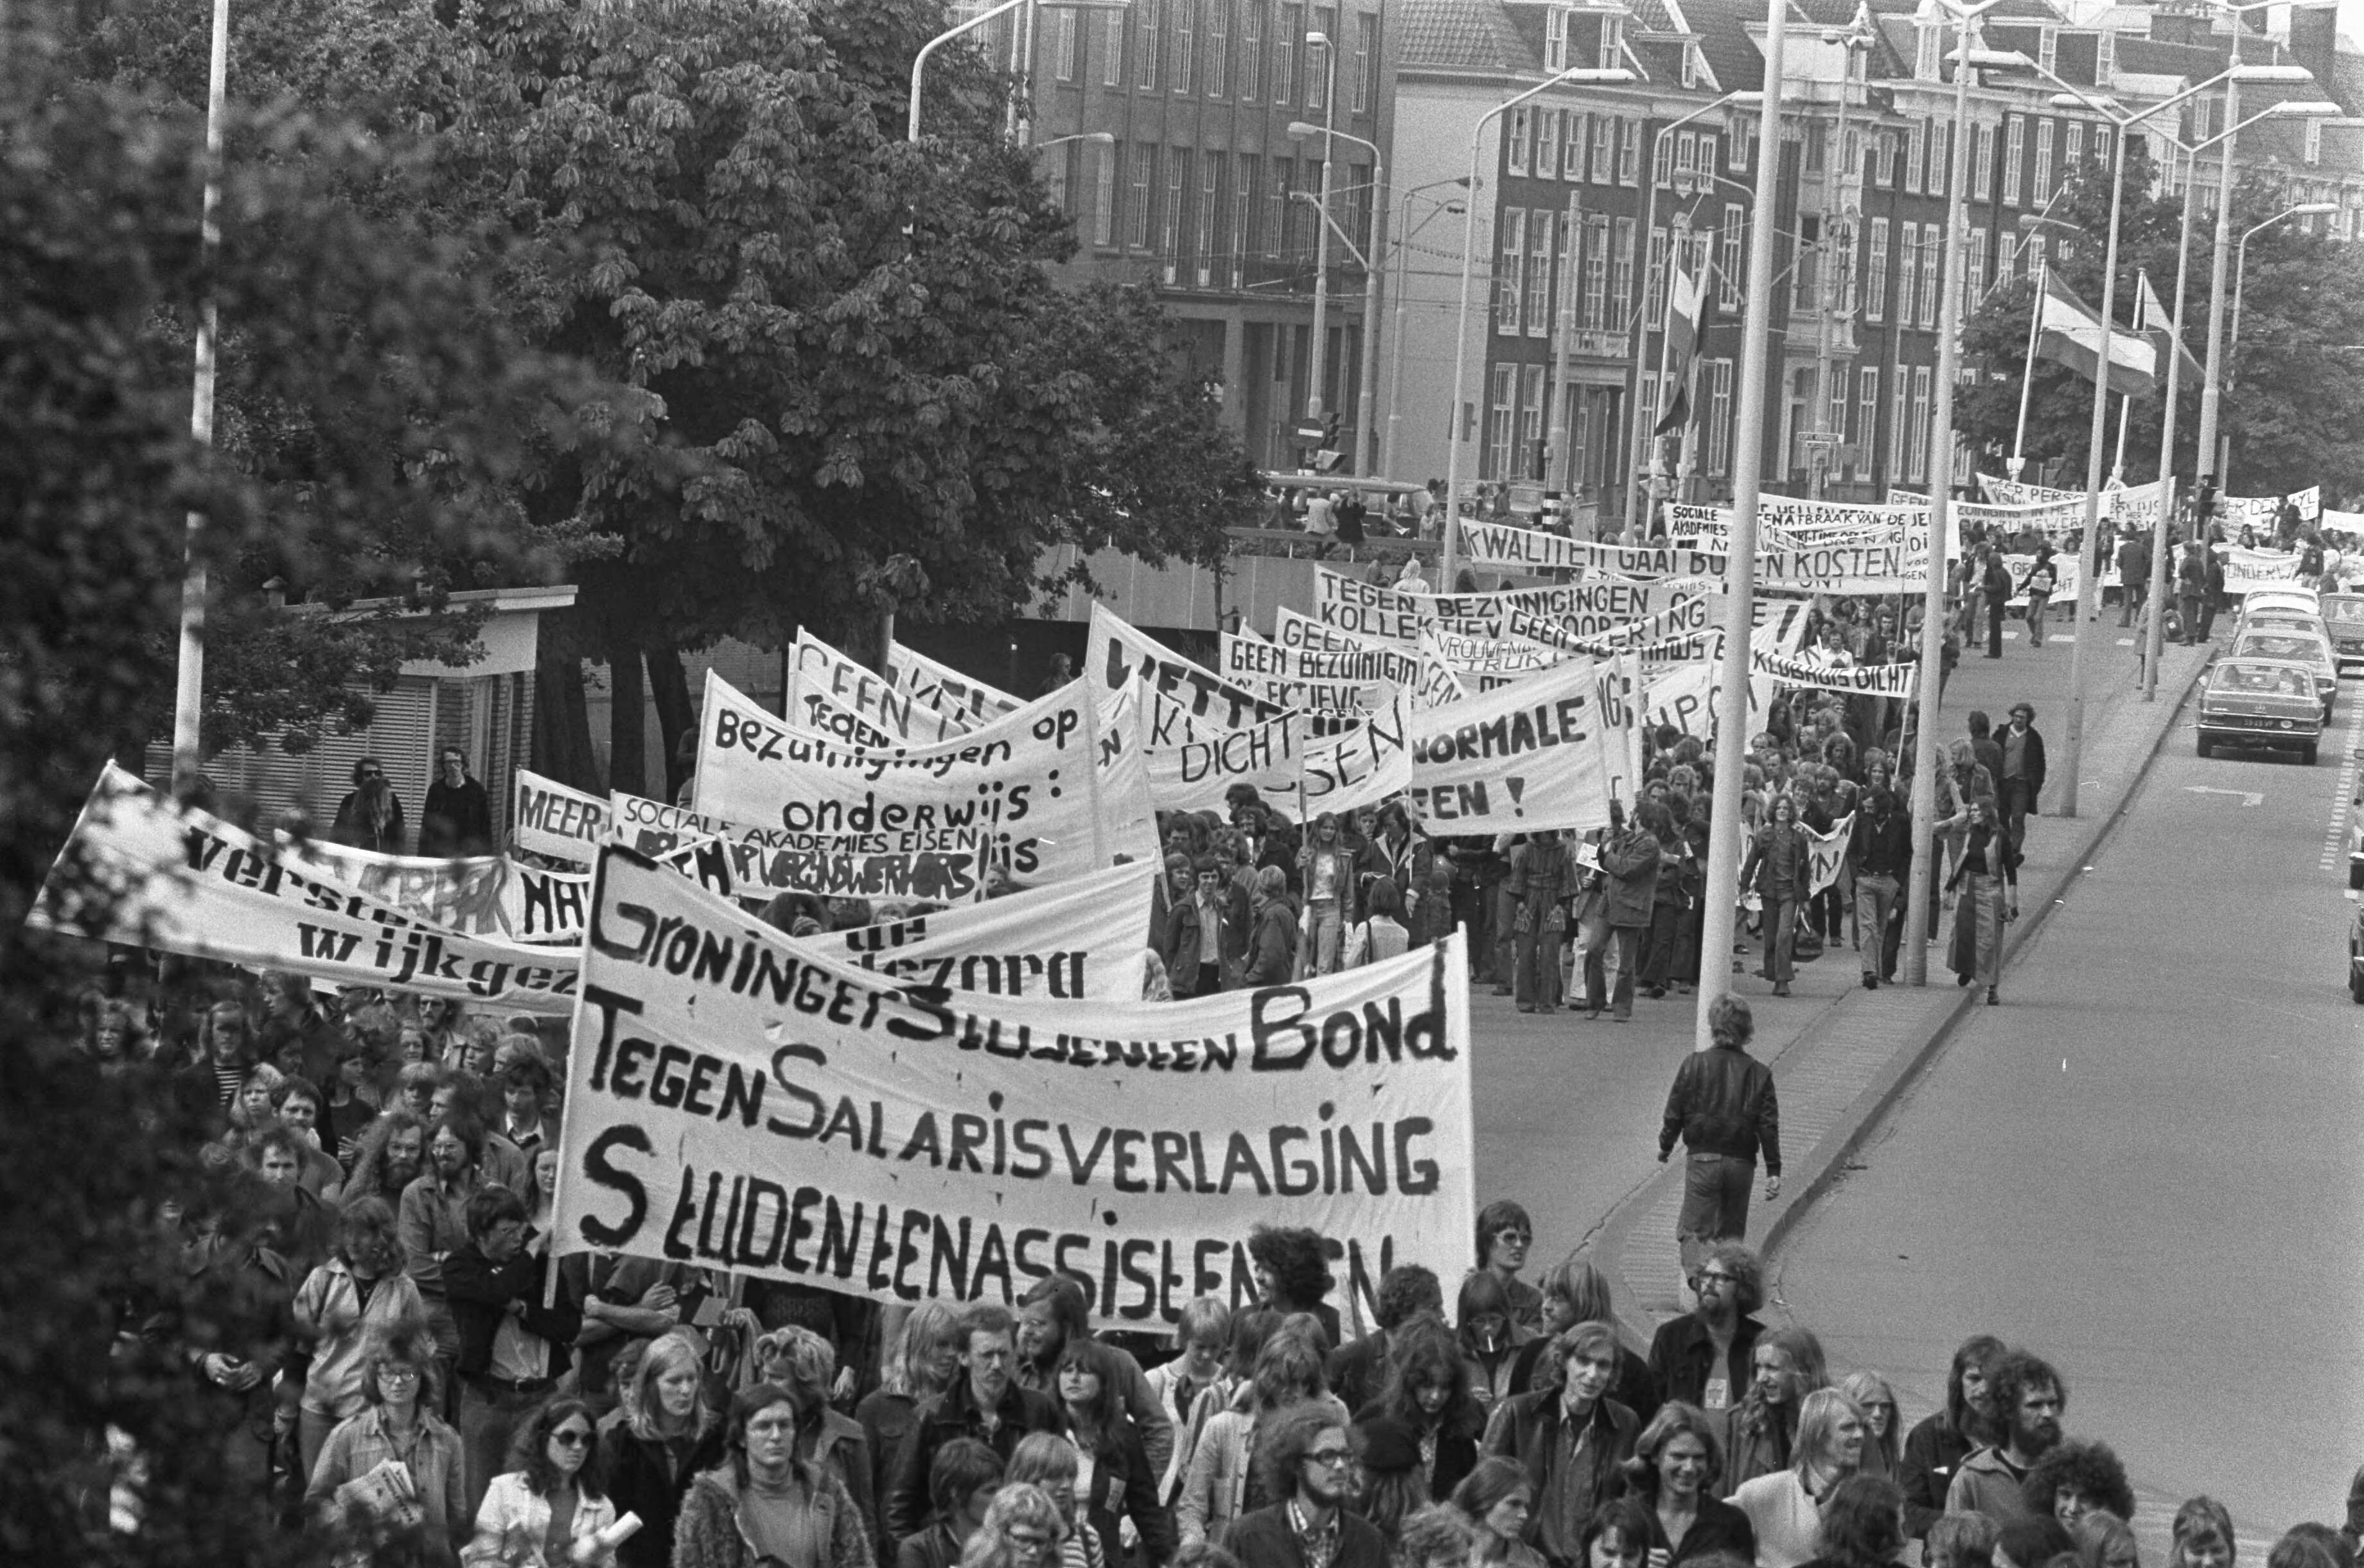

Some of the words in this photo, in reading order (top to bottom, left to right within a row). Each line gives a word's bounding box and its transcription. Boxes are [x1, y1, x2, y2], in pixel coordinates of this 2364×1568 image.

[1672, 505, 1718, 522] SOCIALE
[1857, 514, 1880, 524] VAN
[1887, 513, 1907, 525] DE
[1794, 546, 1900, 578] KOSTEN
[1321, 572, 1416, 613] TEGEN
[1509, 608, 1569, 649] GEEN
[1231, 640, 1287, 674] GEEN
[1754, 648, 1851, 687] KLUBHUIS
[1032, 709, 1078, 750] op
[1181, 709, 1299, 783] DICHT
[519, 784, 602, 842] MEER
[743, 828, 889, 854] AKADEMIES
[583, 983, 767, 1128] TEGEN
